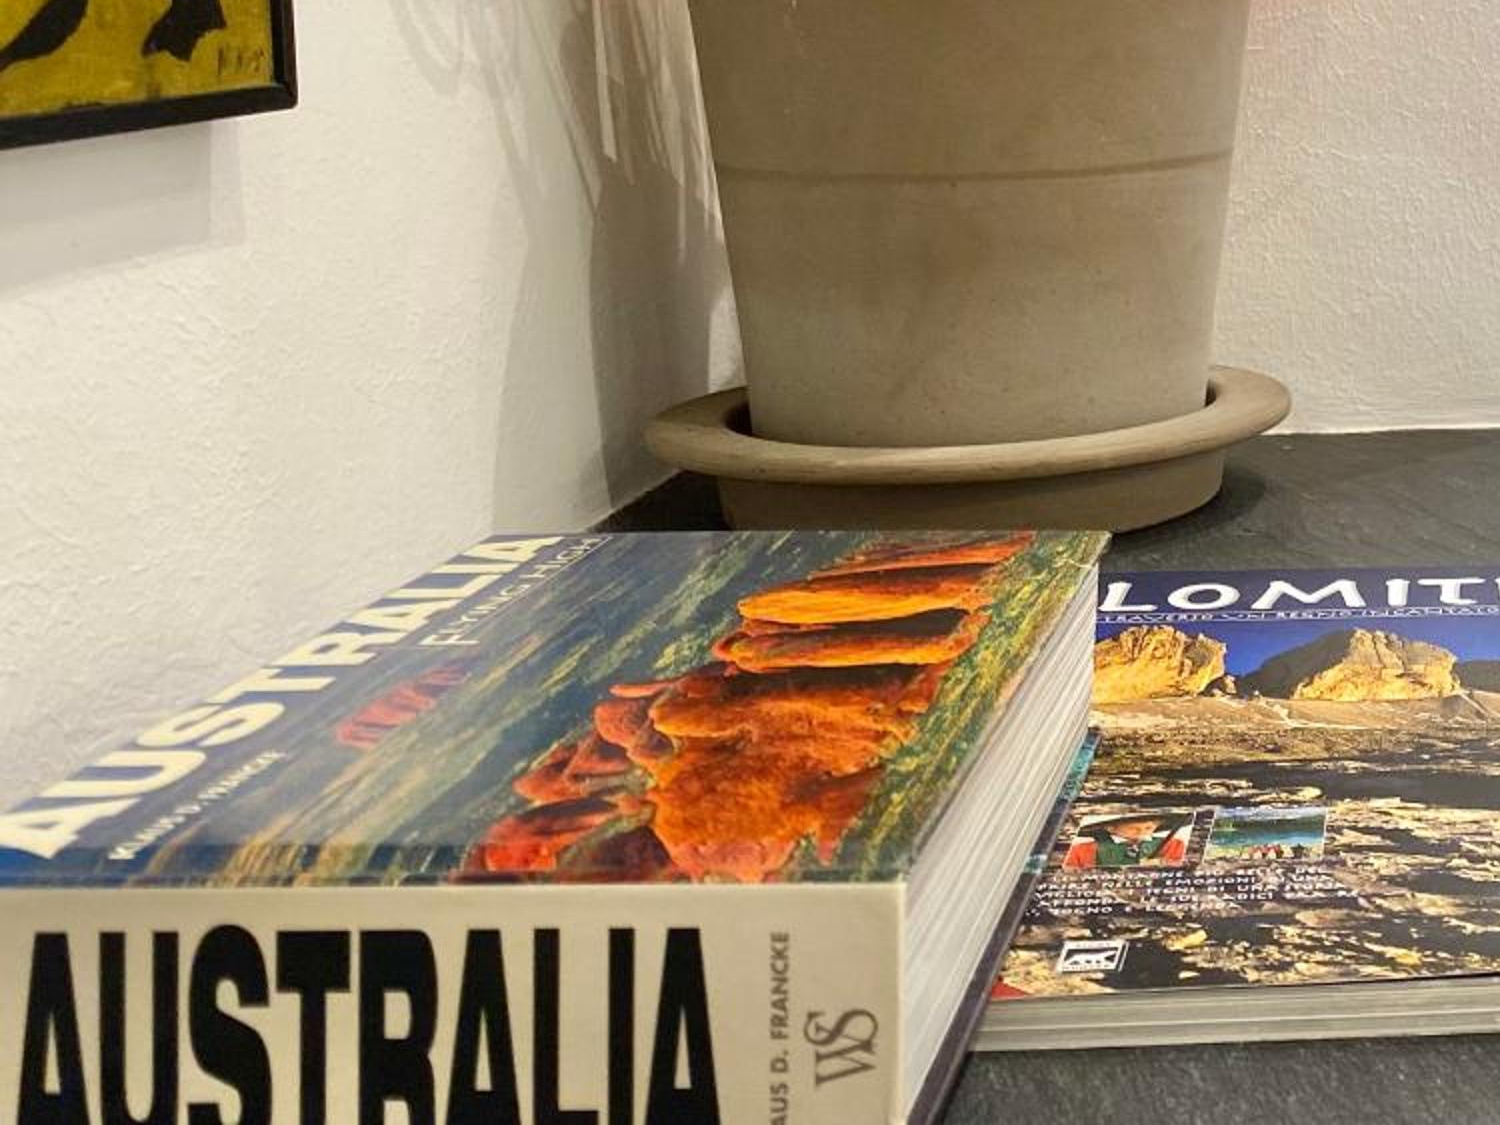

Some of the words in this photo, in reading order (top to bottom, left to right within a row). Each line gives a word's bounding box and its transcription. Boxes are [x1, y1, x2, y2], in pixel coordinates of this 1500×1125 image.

[0, 535, 563, 858] AUSTRALIA
[17, 924, 722, 1125] AUSTRALIA
[769, 931, 790, 1041] FRANCKE
[769, 1049, 790, 1074] D.
[769, 1081, 790, 1125] AUS
